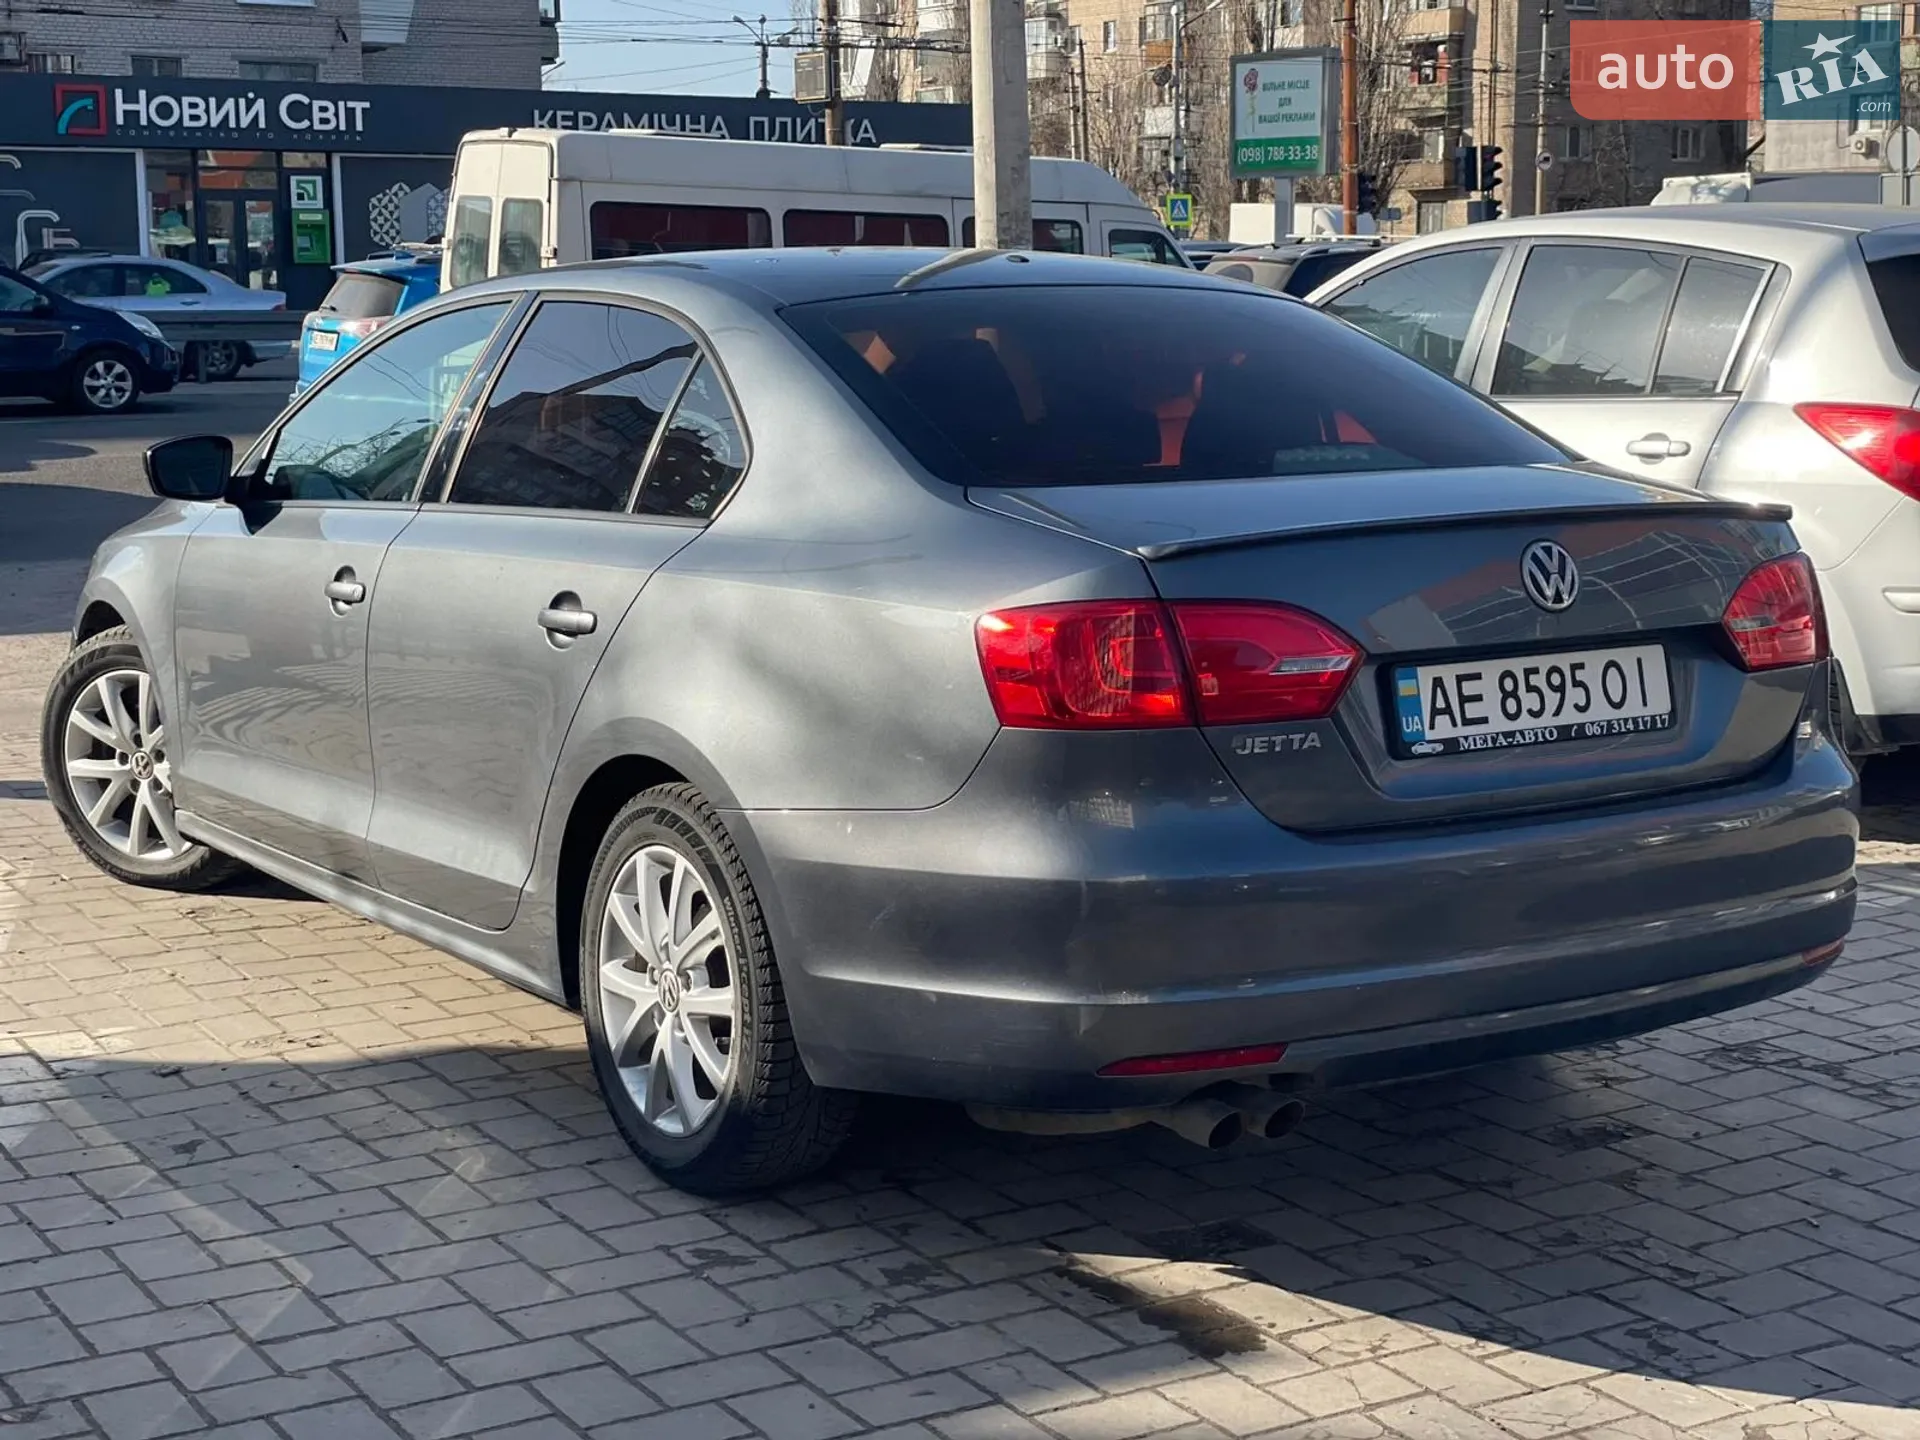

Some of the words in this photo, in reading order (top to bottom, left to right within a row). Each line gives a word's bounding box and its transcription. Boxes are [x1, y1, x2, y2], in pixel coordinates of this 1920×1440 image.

[533, 109, 731, 140] КЕРАМІЧНА
[1237, 146, 1265, 165] (098)
[1267, 144, 1319, 160] 788-33-38
[1428, 671, 1489, 730] AE
[1498, 662, 1591, 722] 8595
[1402, 715, 1423, 732] UA
[1585, 722, 1608, 736] 067
[1611, 719, 1635, 733] 314
[1637, 718, 1652, 731] 17
[1655, 714, 1670, 728] 17
[1234, 732, 1322, 755] JETTA
